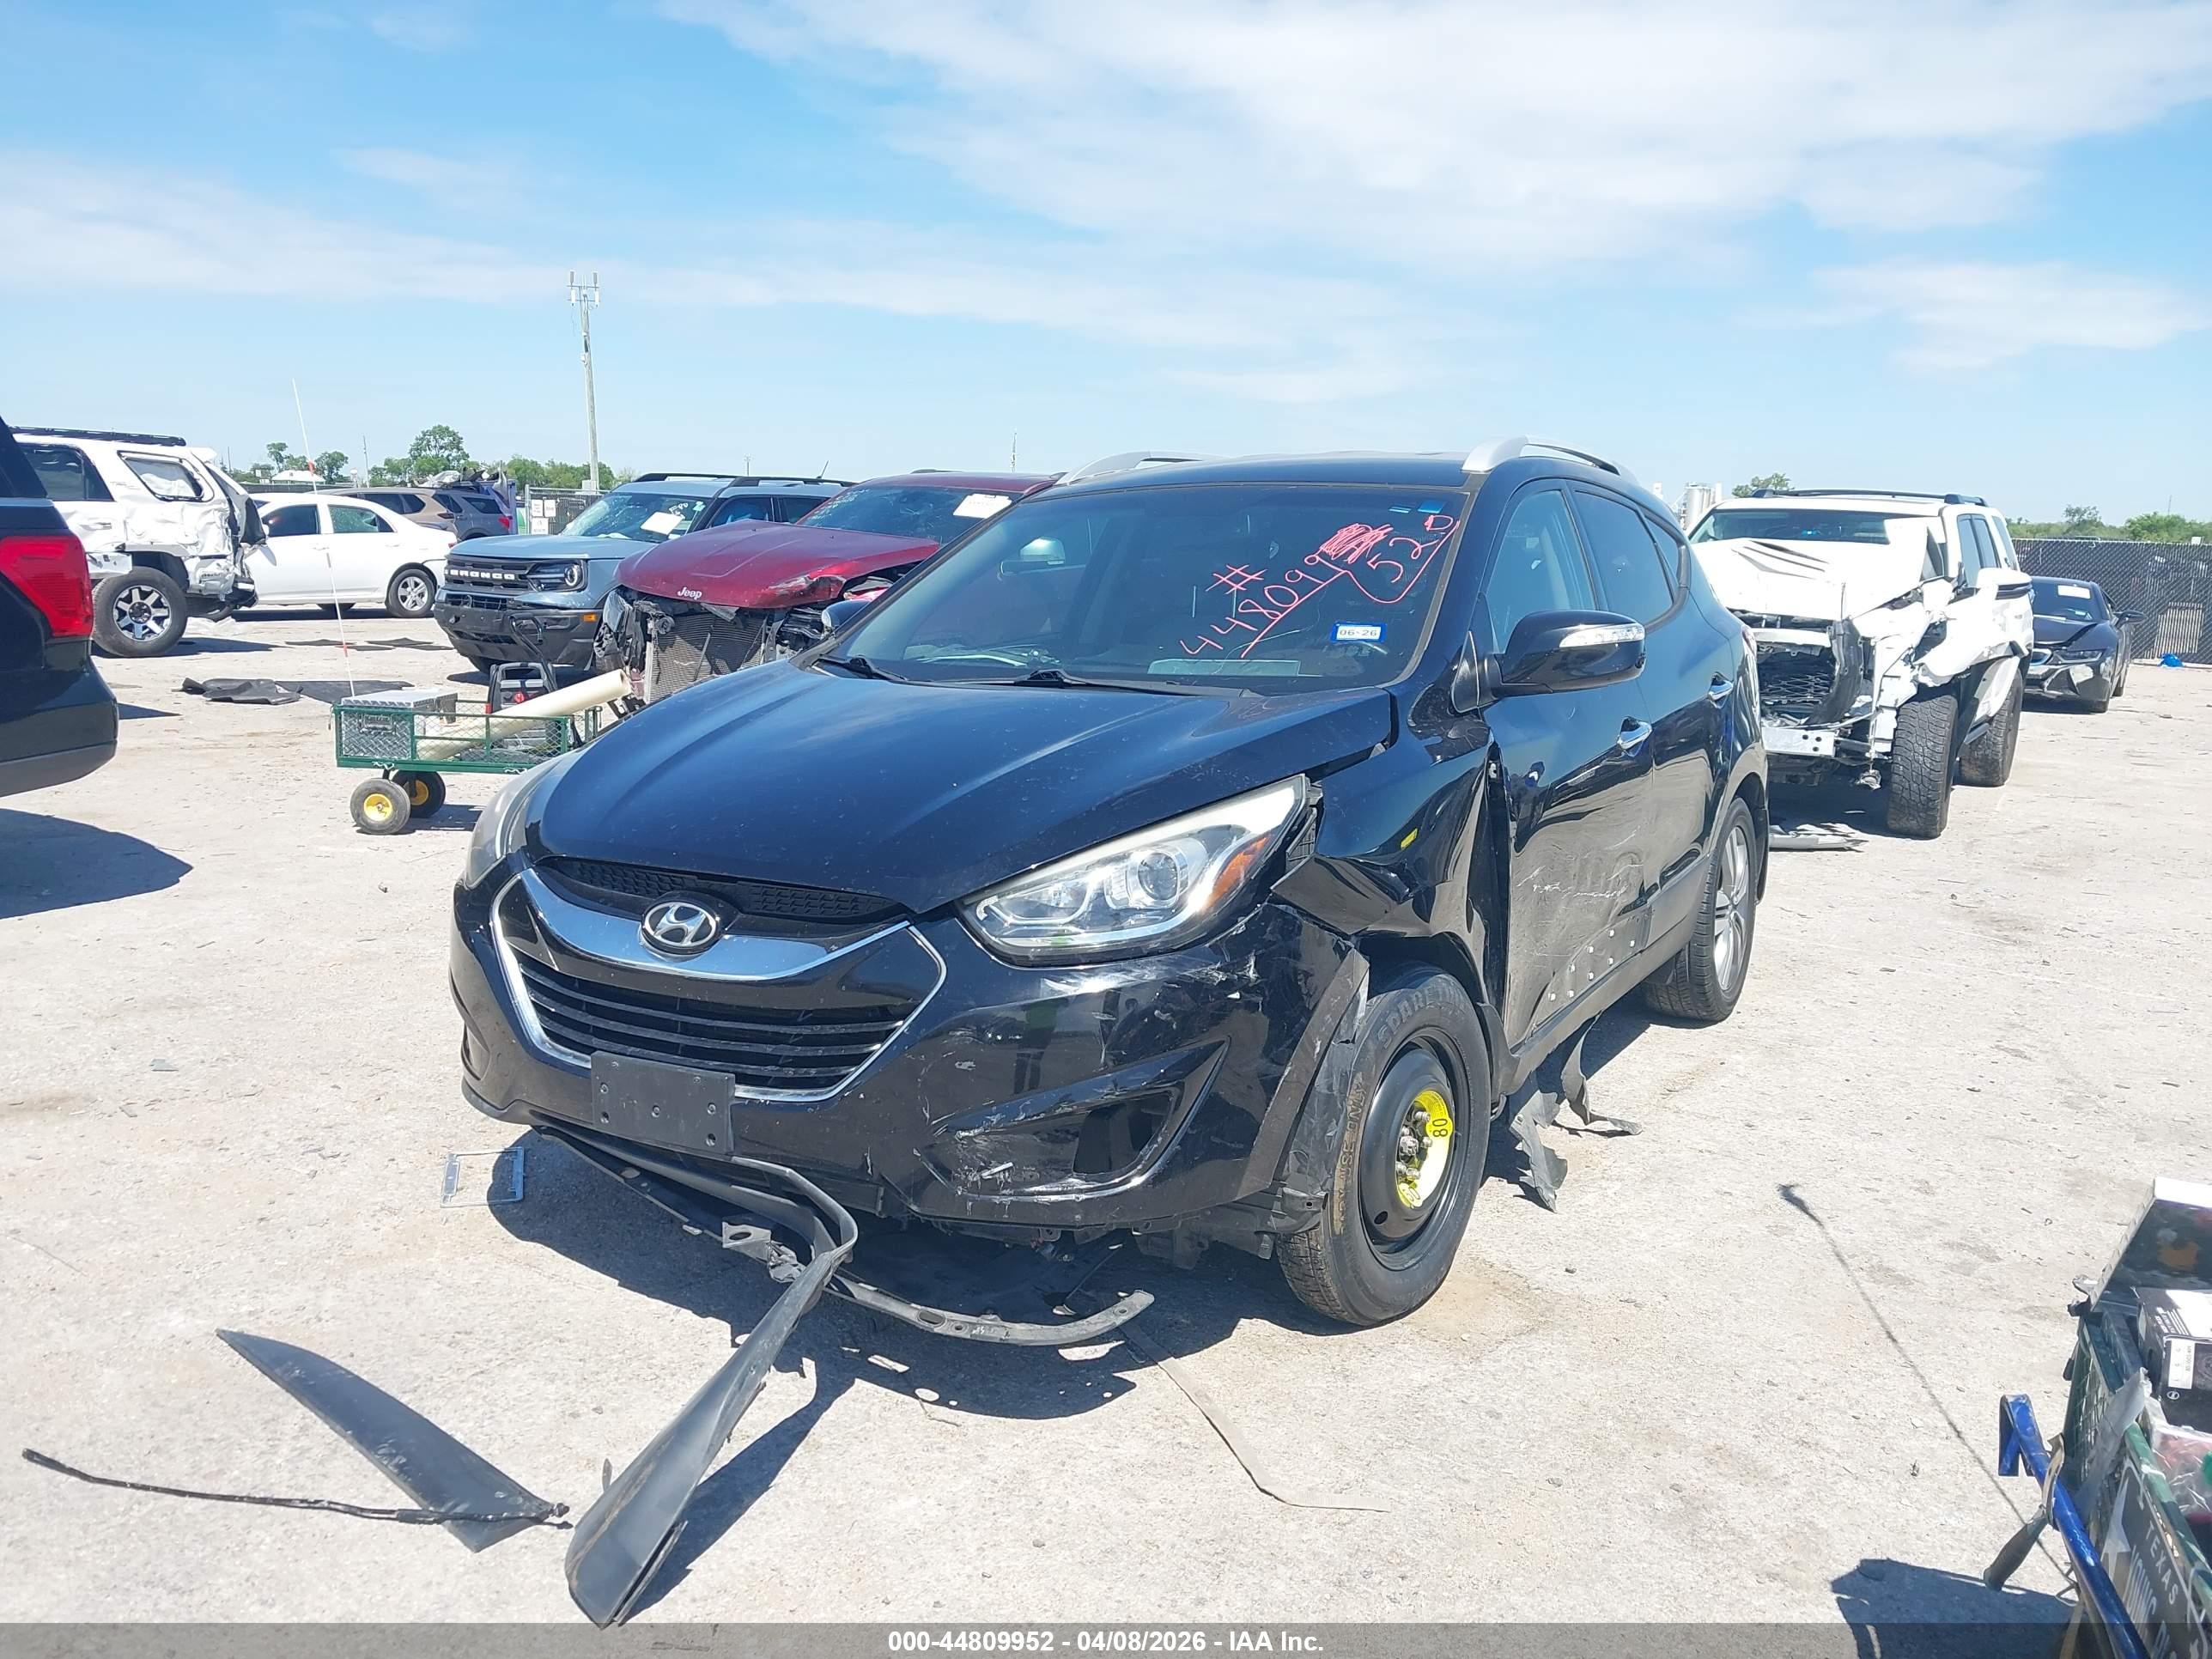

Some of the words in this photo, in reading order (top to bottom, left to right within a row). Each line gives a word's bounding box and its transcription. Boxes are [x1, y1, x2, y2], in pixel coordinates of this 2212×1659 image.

[449, 568, 515, 580] BRONCO
[677, 586, 702, 600] Jeep
[1346, 1083, 1367, 1131] ONLY
[1431, 1118, 1449, 1138] 80
[1339, 1141, 1355, 1180] USE
[2146, 1519, 2179, 1605] TEXAS
